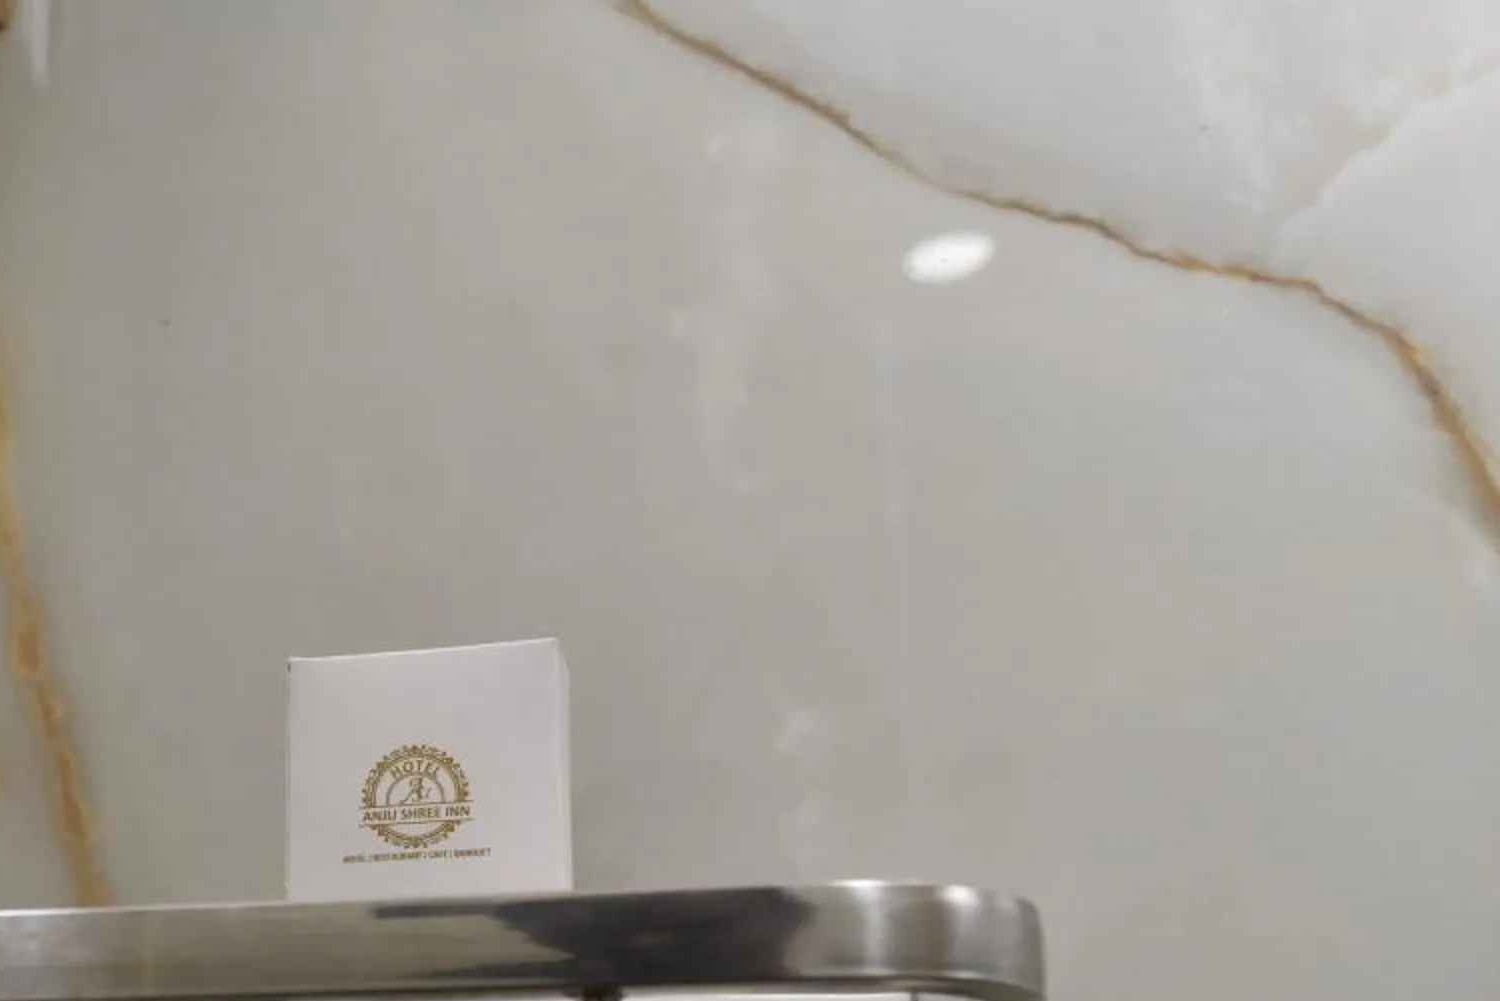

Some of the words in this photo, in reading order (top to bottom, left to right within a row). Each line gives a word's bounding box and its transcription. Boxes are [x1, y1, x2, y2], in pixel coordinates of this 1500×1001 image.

[390, 759, 441, 779] HOTEL
[401, 807, 440, 820] SHREE
[445, 805, 470, 817] INN
